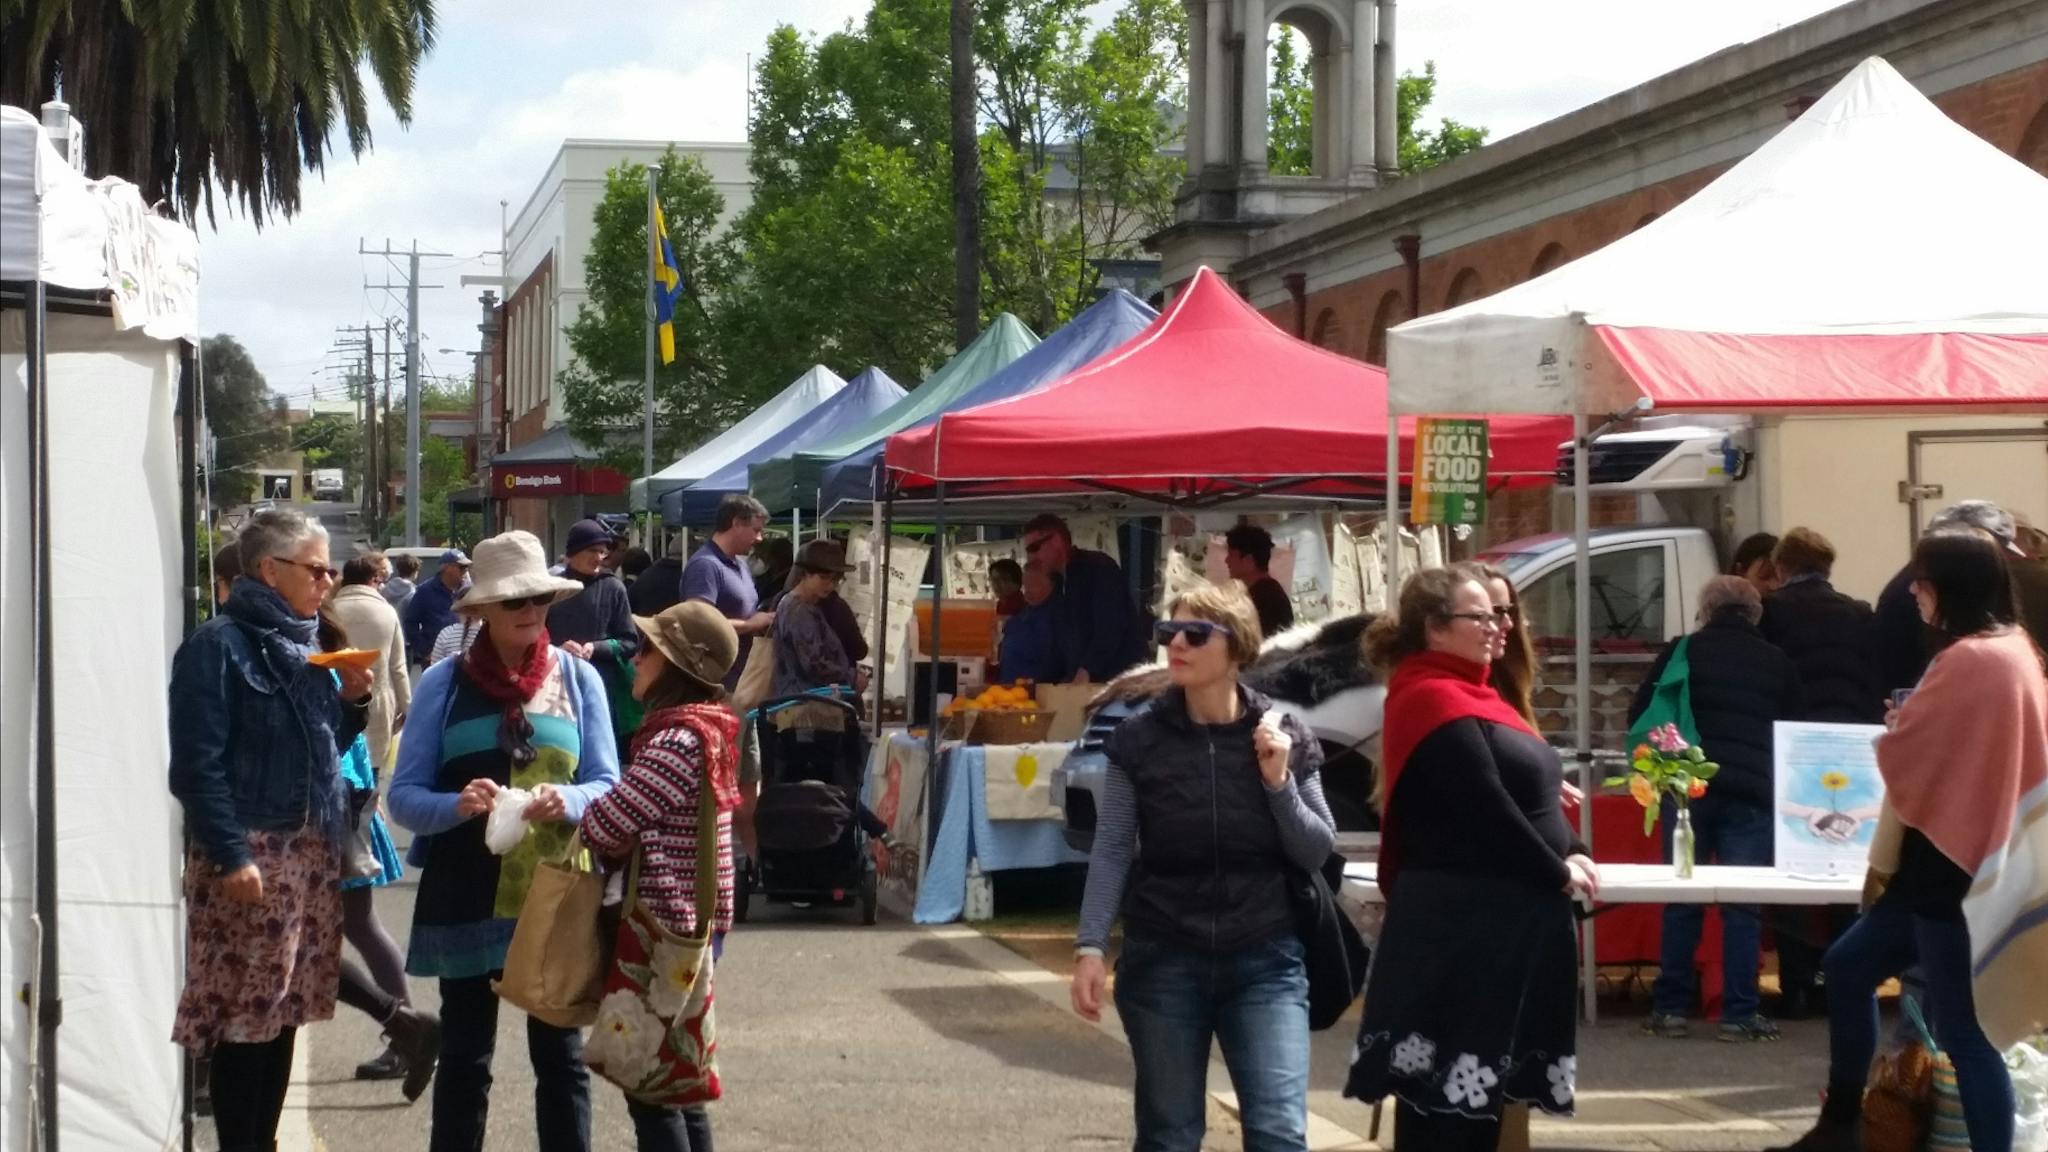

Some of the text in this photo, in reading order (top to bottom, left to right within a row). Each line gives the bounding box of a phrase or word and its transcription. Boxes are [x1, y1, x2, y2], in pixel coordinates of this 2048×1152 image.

[1422, 434, 1482, 456] LOCAL
[1421, 457, 1481, 481] FOOD
[515, 474, 562, 487] Bendigo Bank
[1420, 482, 1480, 494] REVOLUTION
